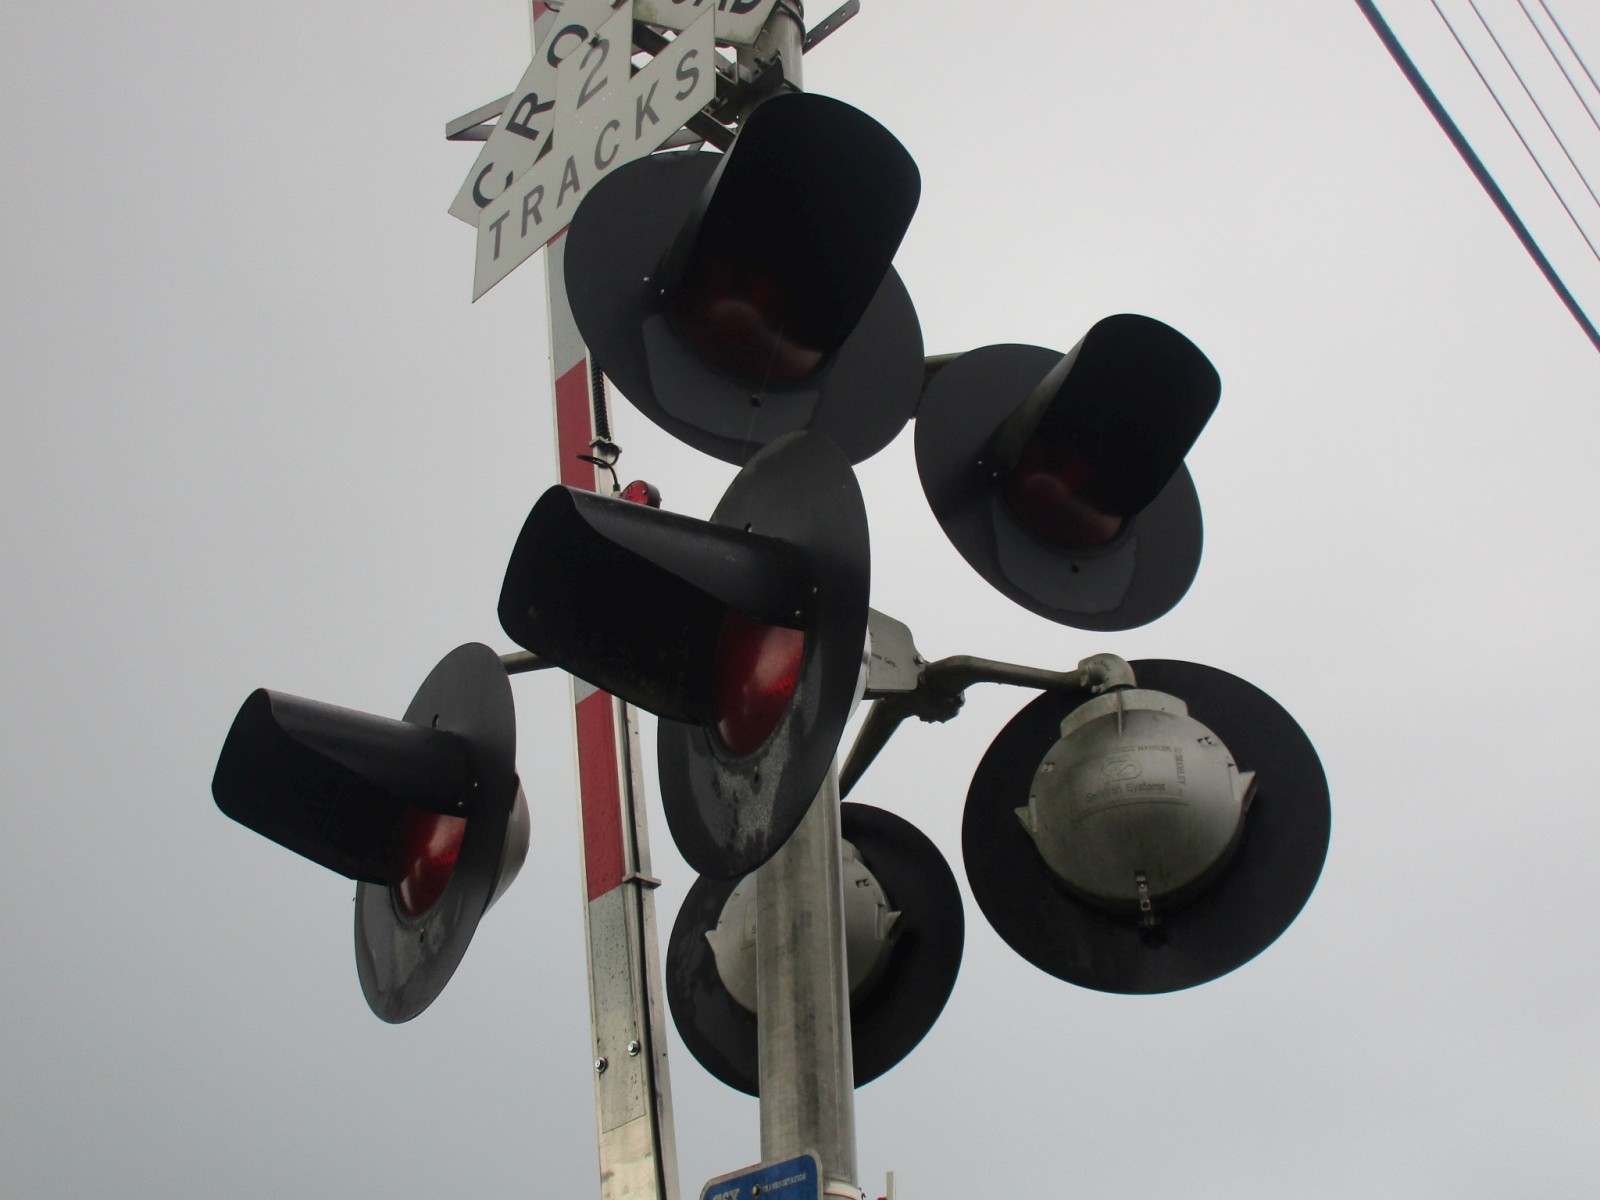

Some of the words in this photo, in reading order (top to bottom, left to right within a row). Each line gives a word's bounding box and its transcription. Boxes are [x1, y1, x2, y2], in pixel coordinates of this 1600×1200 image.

[472, 0, 626, 209] CRO
[488, 48, 700, 262] TRACKS
[577, 38, 611, 110] 2
